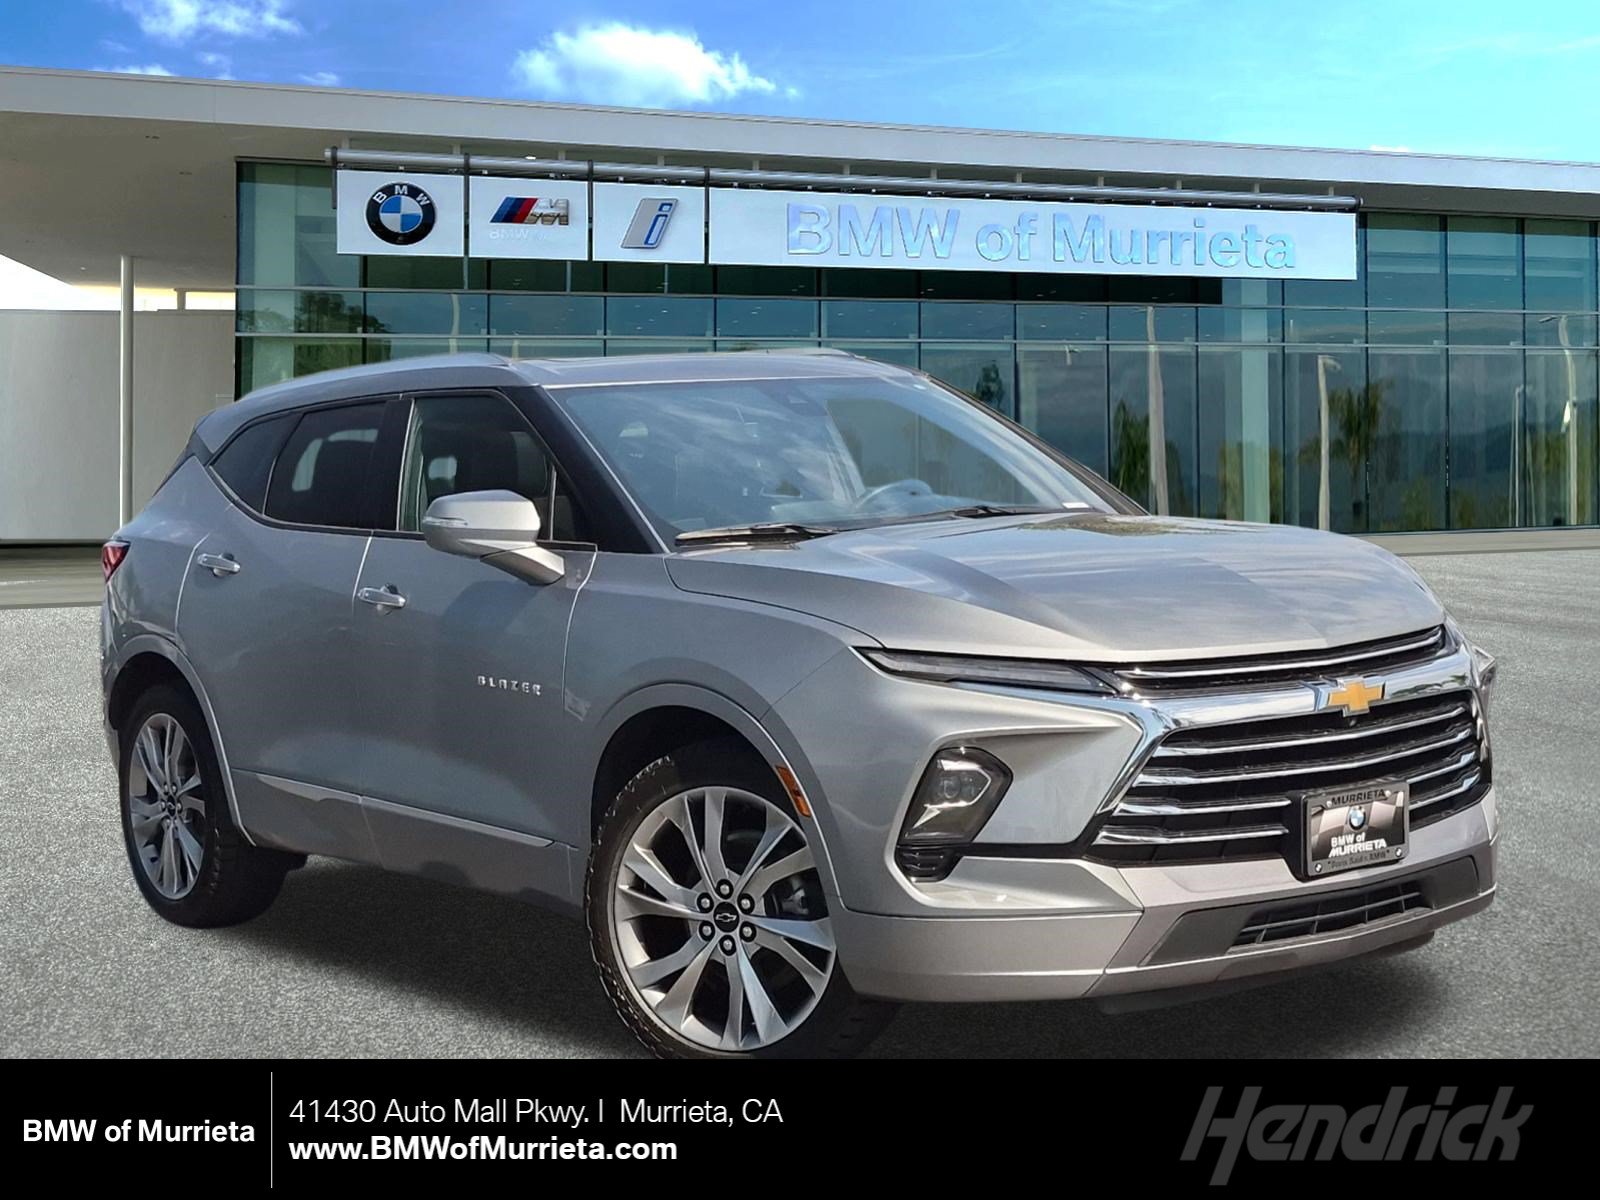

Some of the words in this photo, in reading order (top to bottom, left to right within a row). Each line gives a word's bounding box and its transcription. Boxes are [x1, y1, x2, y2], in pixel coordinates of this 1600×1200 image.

[372, 185, 431, 206] BMW
[786, 202, 960, 258] BMW
[976, 212, 1039, 263] of
[1053, 211, 1297, 269] Murrieta
[477, 675, 541, 696] BLAZER
[1331, 788, 1386, 806] MURRIETA
[1328, 838, 1388, 858] MURRIETA
[1331, 833, 1355, 848] BMW
[1355, 831, 1366, 842] of
